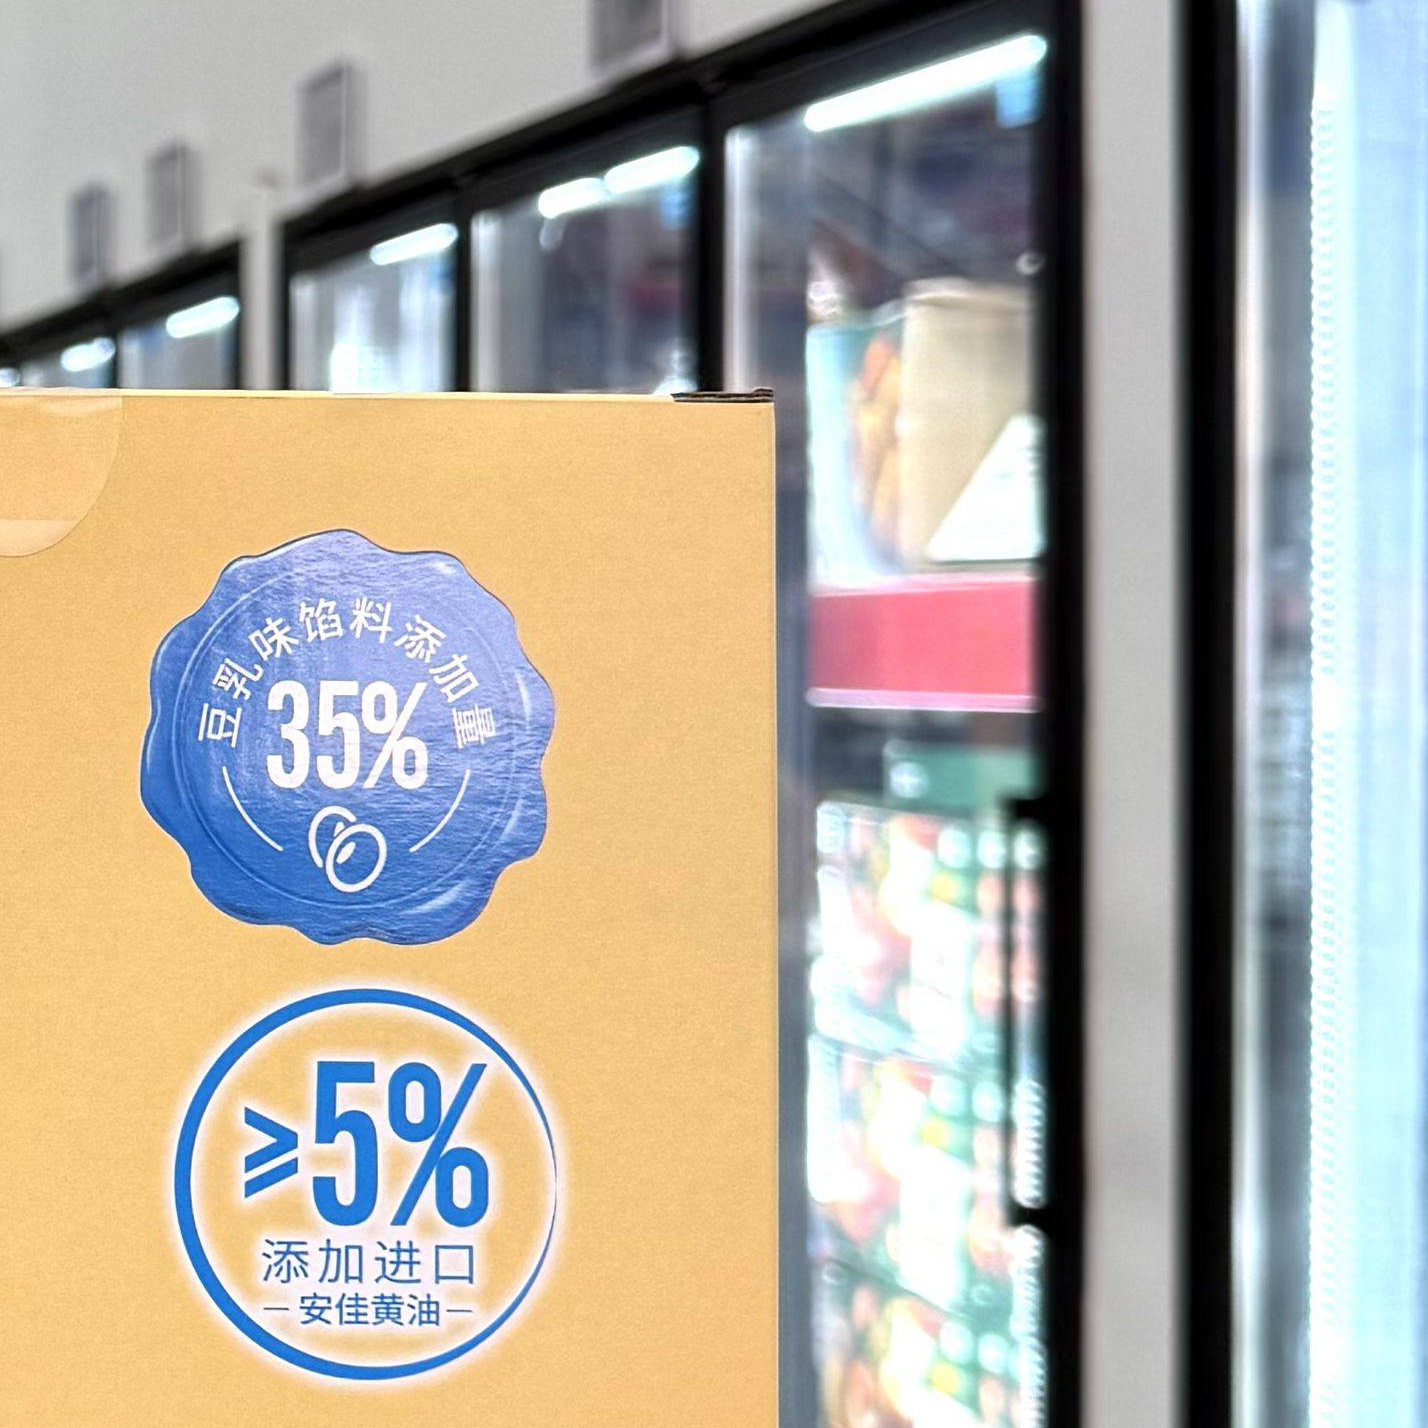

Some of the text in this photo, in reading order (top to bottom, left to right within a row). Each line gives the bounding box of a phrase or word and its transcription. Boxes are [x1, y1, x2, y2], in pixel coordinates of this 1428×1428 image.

[198, 597, 496, 750] 豆乳味馅料添加量
[266, 680, 428, 789] 35%
[245, 1061, 489, 1227] ≥5%
[262, 1238, 474, 1284] 添加进口
[299, 1293, 441, 1326] 安佳黄油
